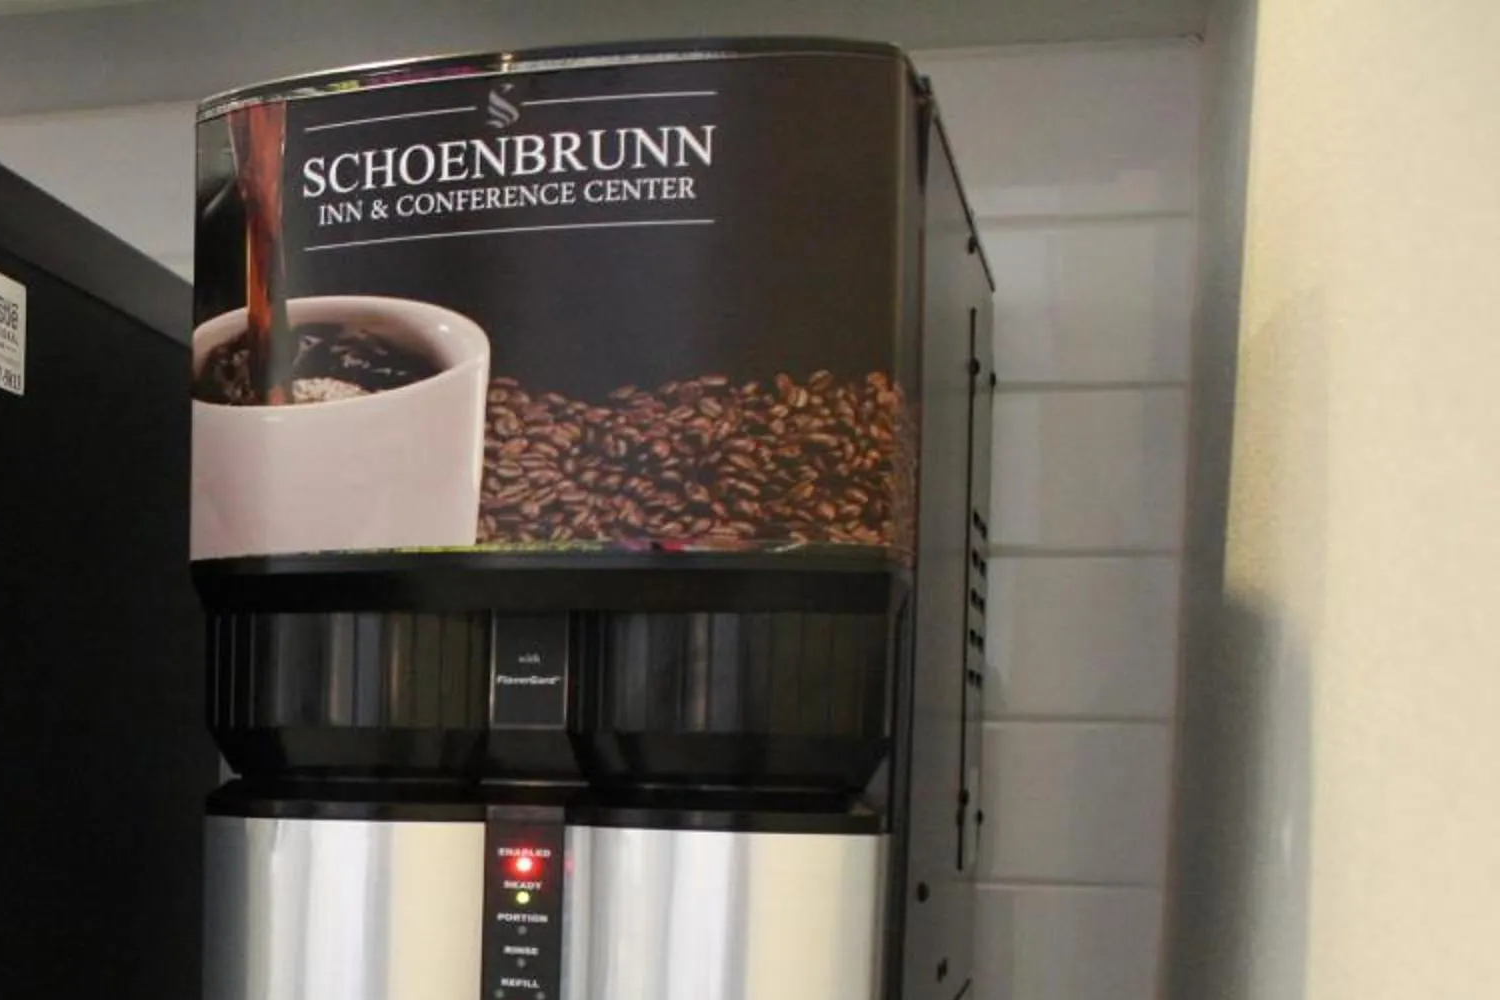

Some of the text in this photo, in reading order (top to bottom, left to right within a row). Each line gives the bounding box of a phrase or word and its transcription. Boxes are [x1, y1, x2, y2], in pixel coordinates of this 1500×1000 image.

[303, 125, 717, 198] SCHOENBRUNN
[319, 176, 698, 226] INN & CONFERENCE CENTER
[504, 880, 542, 890] READY
[497, 912, 548, 923] PORTION
[503, 945, 539, 956] RINSE
[501, 977, 540, 989] REFILL
